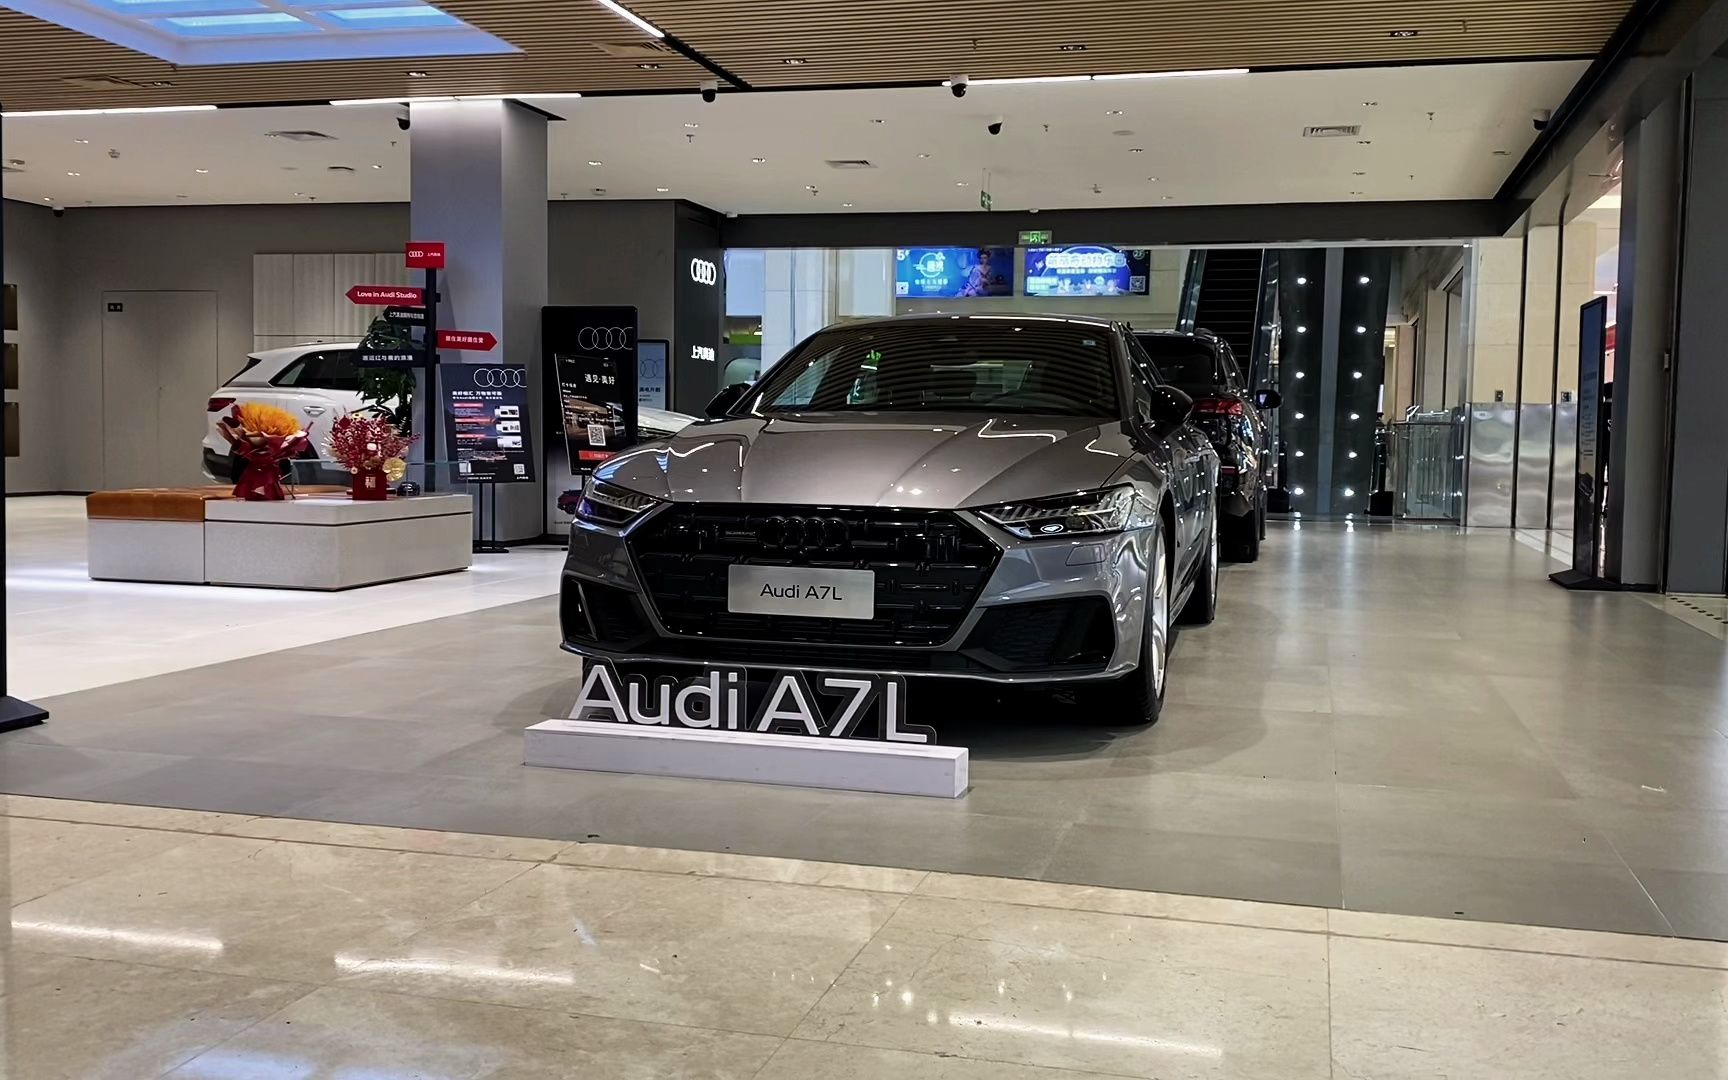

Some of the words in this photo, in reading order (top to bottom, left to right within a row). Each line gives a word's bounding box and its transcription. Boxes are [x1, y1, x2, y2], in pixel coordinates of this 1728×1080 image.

[380, 291, 395, 299] Audi
[759, 583, 801, 600] Audi
[805, 585, 843, 601] A7L
[568, 664, 738, 730] Audi
[757, 675, 927, 744] A7L
